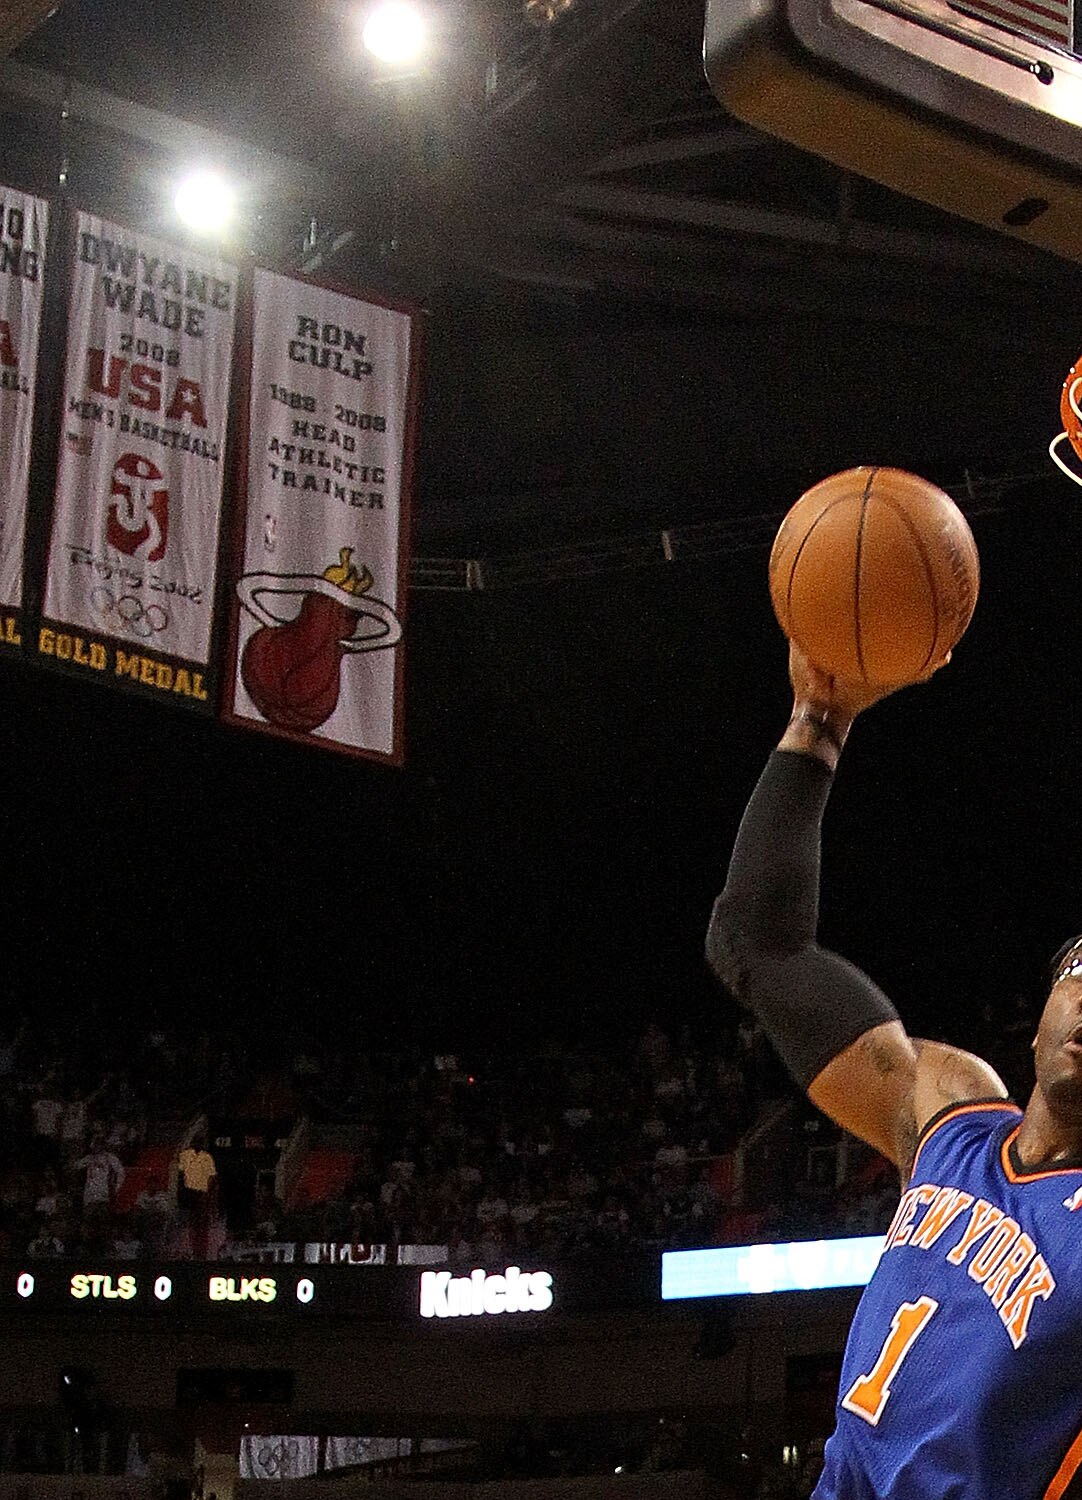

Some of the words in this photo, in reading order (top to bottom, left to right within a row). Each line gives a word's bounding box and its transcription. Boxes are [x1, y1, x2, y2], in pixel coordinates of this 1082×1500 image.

[80, 231, 231, 311] DWYANE
[103, 275, 205, 337] WADE
[288, 340, 374, 381] CULP
[297, 315, 367, 356] RON
[86, 349, 208, 428] USA
[268, 437, 386, 484] ATHLETIC
[293, 419, 356, 453] HEAD
[268, 463, 385, 510] TRAINER
[39, 627, 107, 671] GOLD
[116, 650, 208, 700] MEDAL
[16, 1272, 35, 1298] 0
[70, 1273, 137, 1300] STLS
[154, 1275, 173, 1301] 0
[208, 1276, 277, 1303] BLKS
[296, 1278, 315, 1304] 0
[420, 1266, 554, 1318] Knicks
[945, 1197, 1057, 1351] YORK
[841, 1295, 939, 1428] 1
